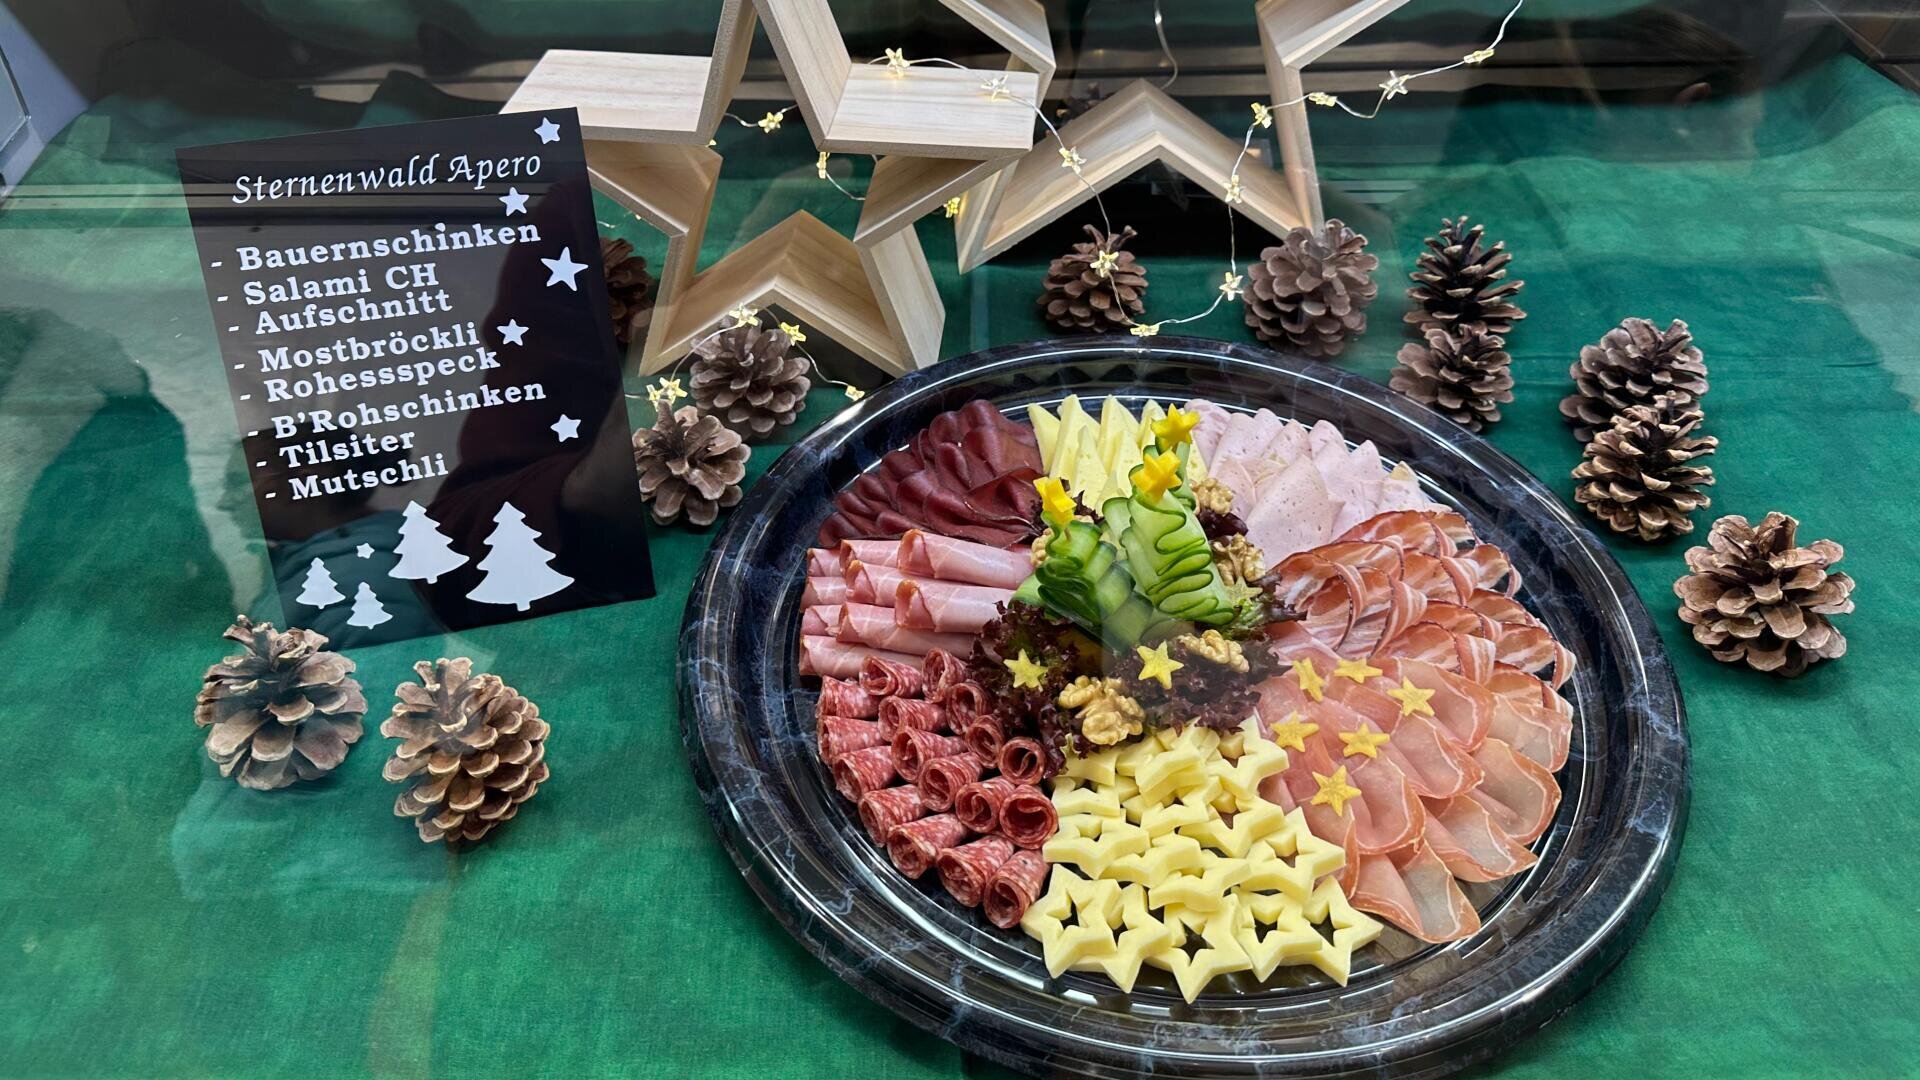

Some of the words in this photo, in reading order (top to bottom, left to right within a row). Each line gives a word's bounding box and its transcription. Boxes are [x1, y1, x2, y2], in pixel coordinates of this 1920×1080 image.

[231, 153, 440, 204] Sternenwald
[447, 154, 541, 191] Apero
[235, 222, 542, 271] Bauernschinken
[243, 268, 372, 306] Salami
[385, 262, 440, 290] CH
[255, 289, 453, 335] Aufschnitt
[257, 321, 481, 373] Mostbröckli
[263, 346, 501, 403] Rohessspeck
[278, 431, 416, 468] Tilsiter
[288, 452, 449, 500] Mutschli
